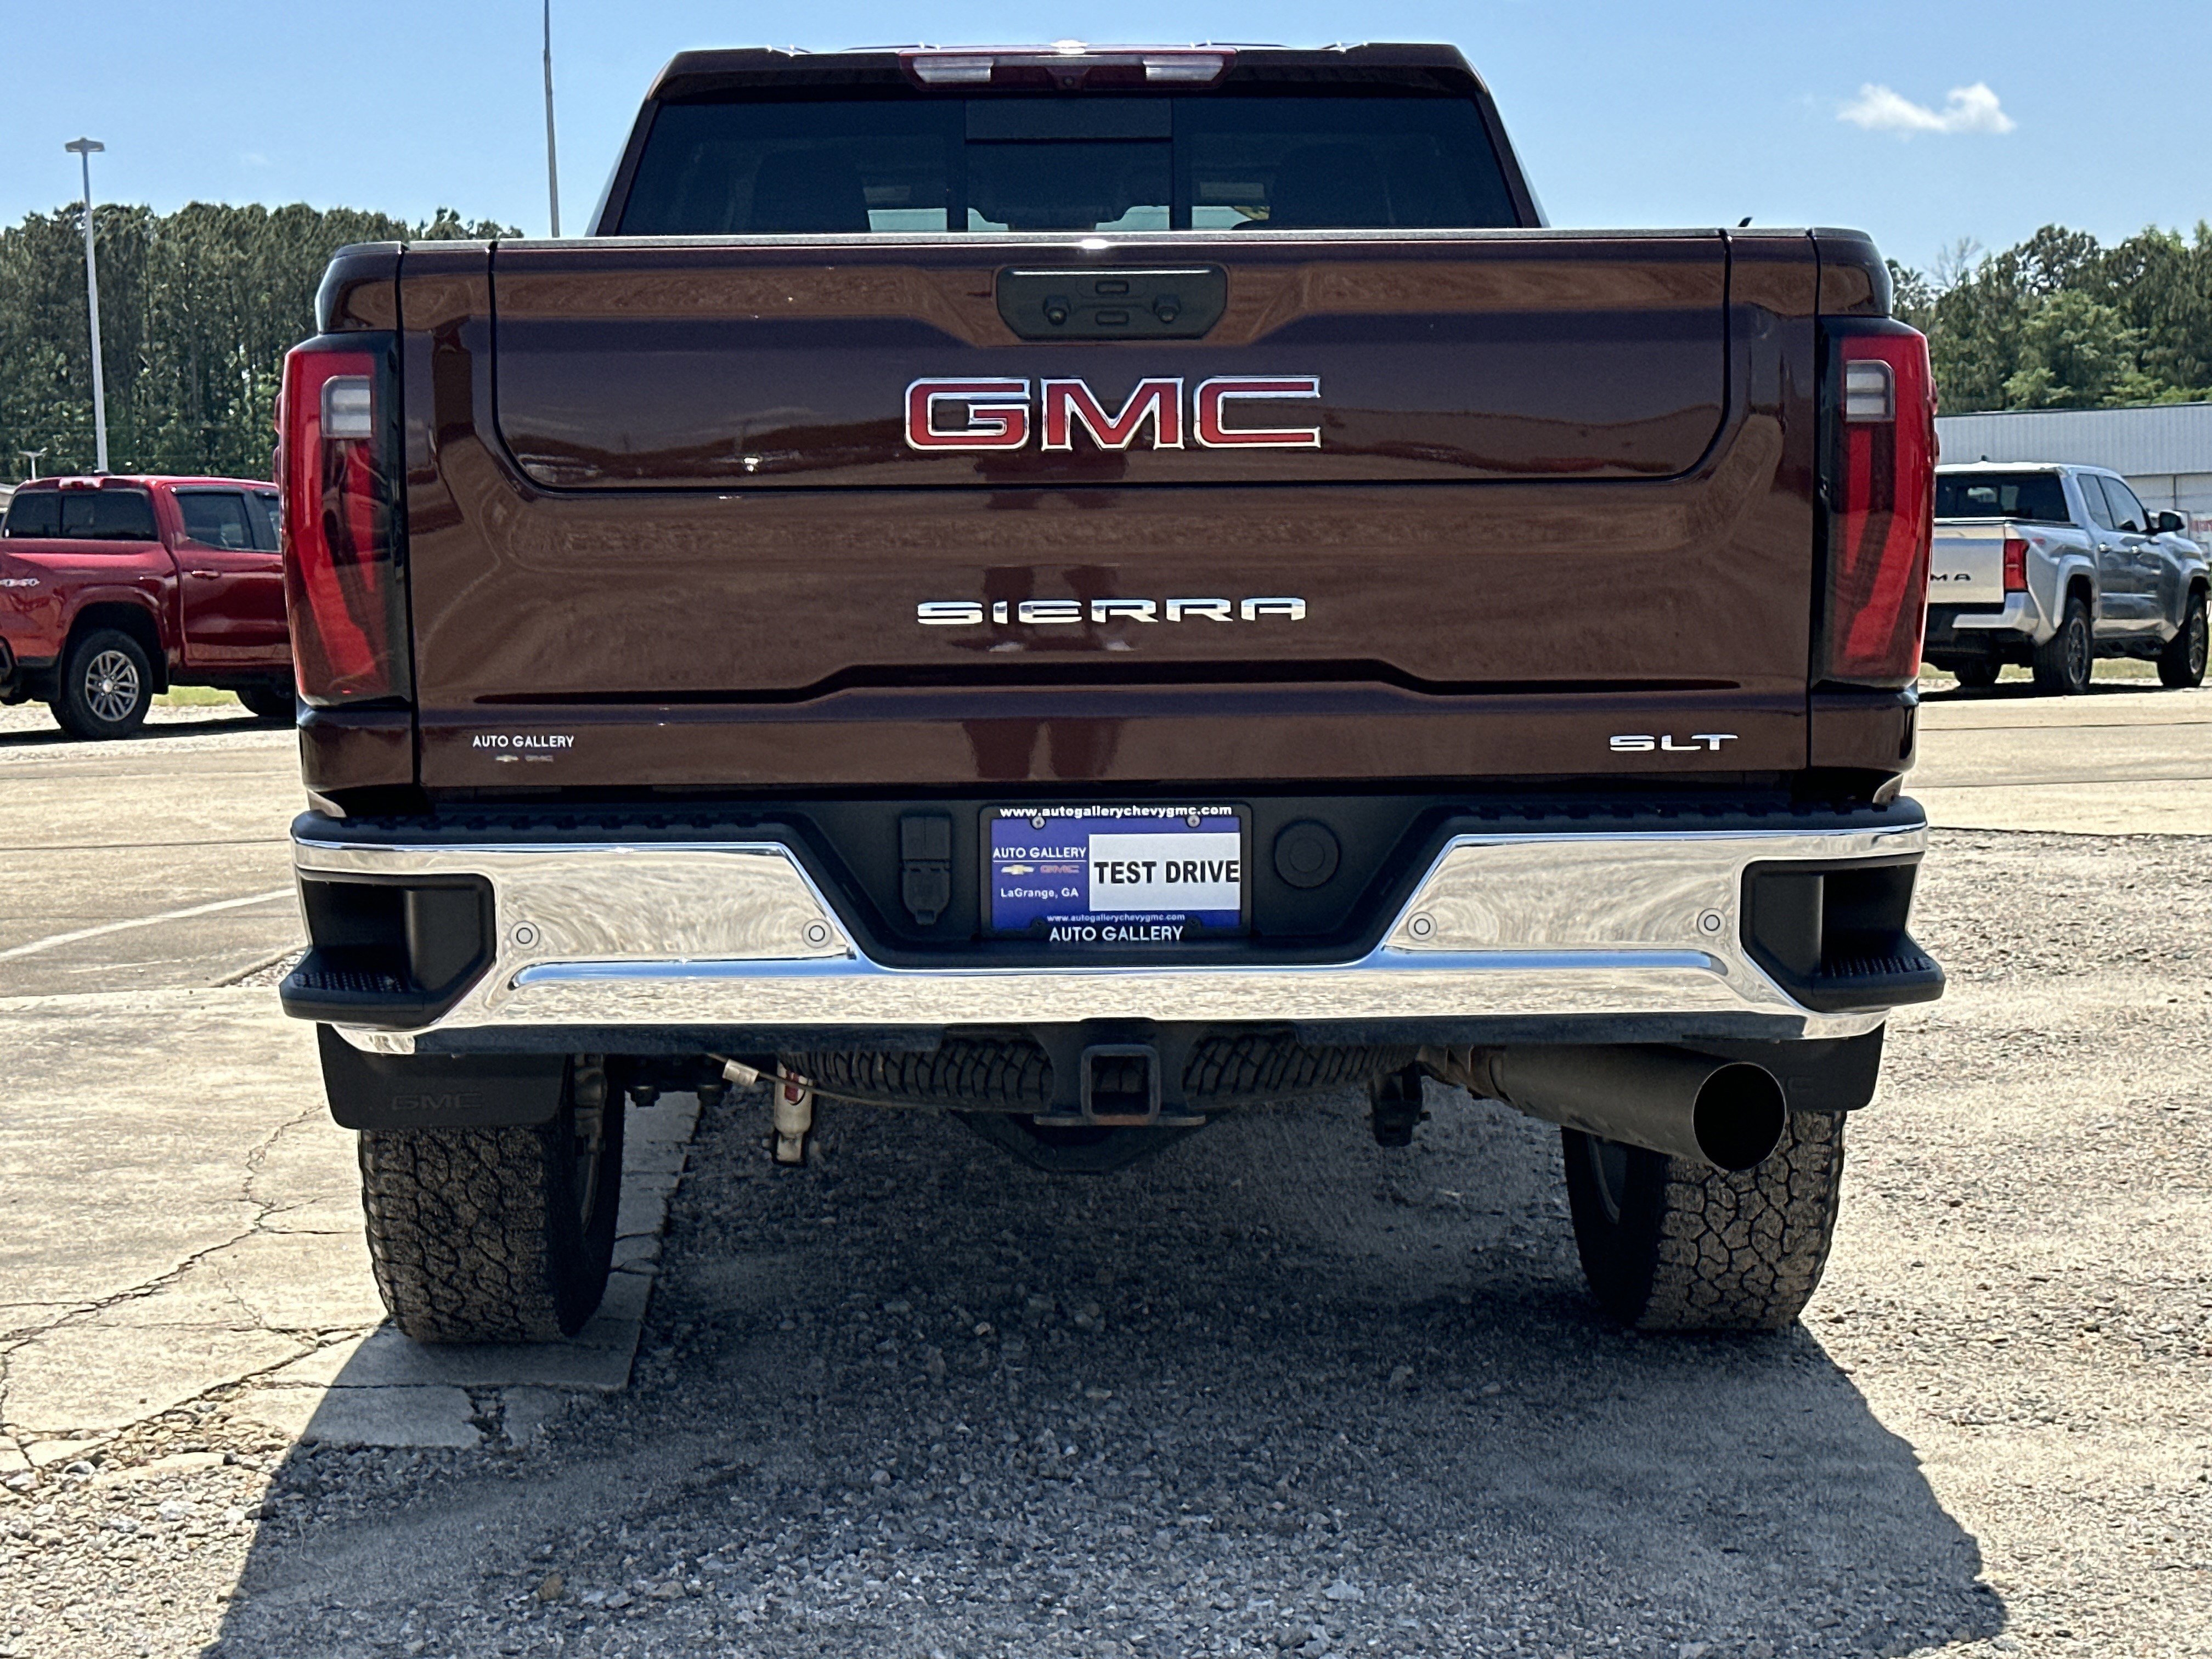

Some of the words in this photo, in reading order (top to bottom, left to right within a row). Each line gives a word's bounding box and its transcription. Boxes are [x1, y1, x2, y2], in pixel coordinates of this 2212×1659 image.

[905, 376, 1321, 450] GMC
[917, 597, 1306, 625] SIERRA
[472, 735, 509, 748] AUTO
[512, 735, 574, 748] GALLERY
[1610, 734, 1739, 751] SLT
[1000, 805, 1232, 819] www.autogallerychevygmc.com
[992, 847, 1026, 859] AUTO
[1029, 847, 1087, 859] GALLERY
[1040, 865, 1080, 874] GMC
[1093, 860, 1157, 884] TEST
[1165, 860, 1240, 884] DRIVE
[1001, 888, 1058, 900] LaGrange,
[1061, 887, 1079, 898] GA
[1047, 913, 1186, 923] www.autogallerychevygmc.com
[1049, 926, 1097, 942] AUTO
[1102, 925, 1183, 942] GALLERY
[392, 1092, 483, 1110] GMC
